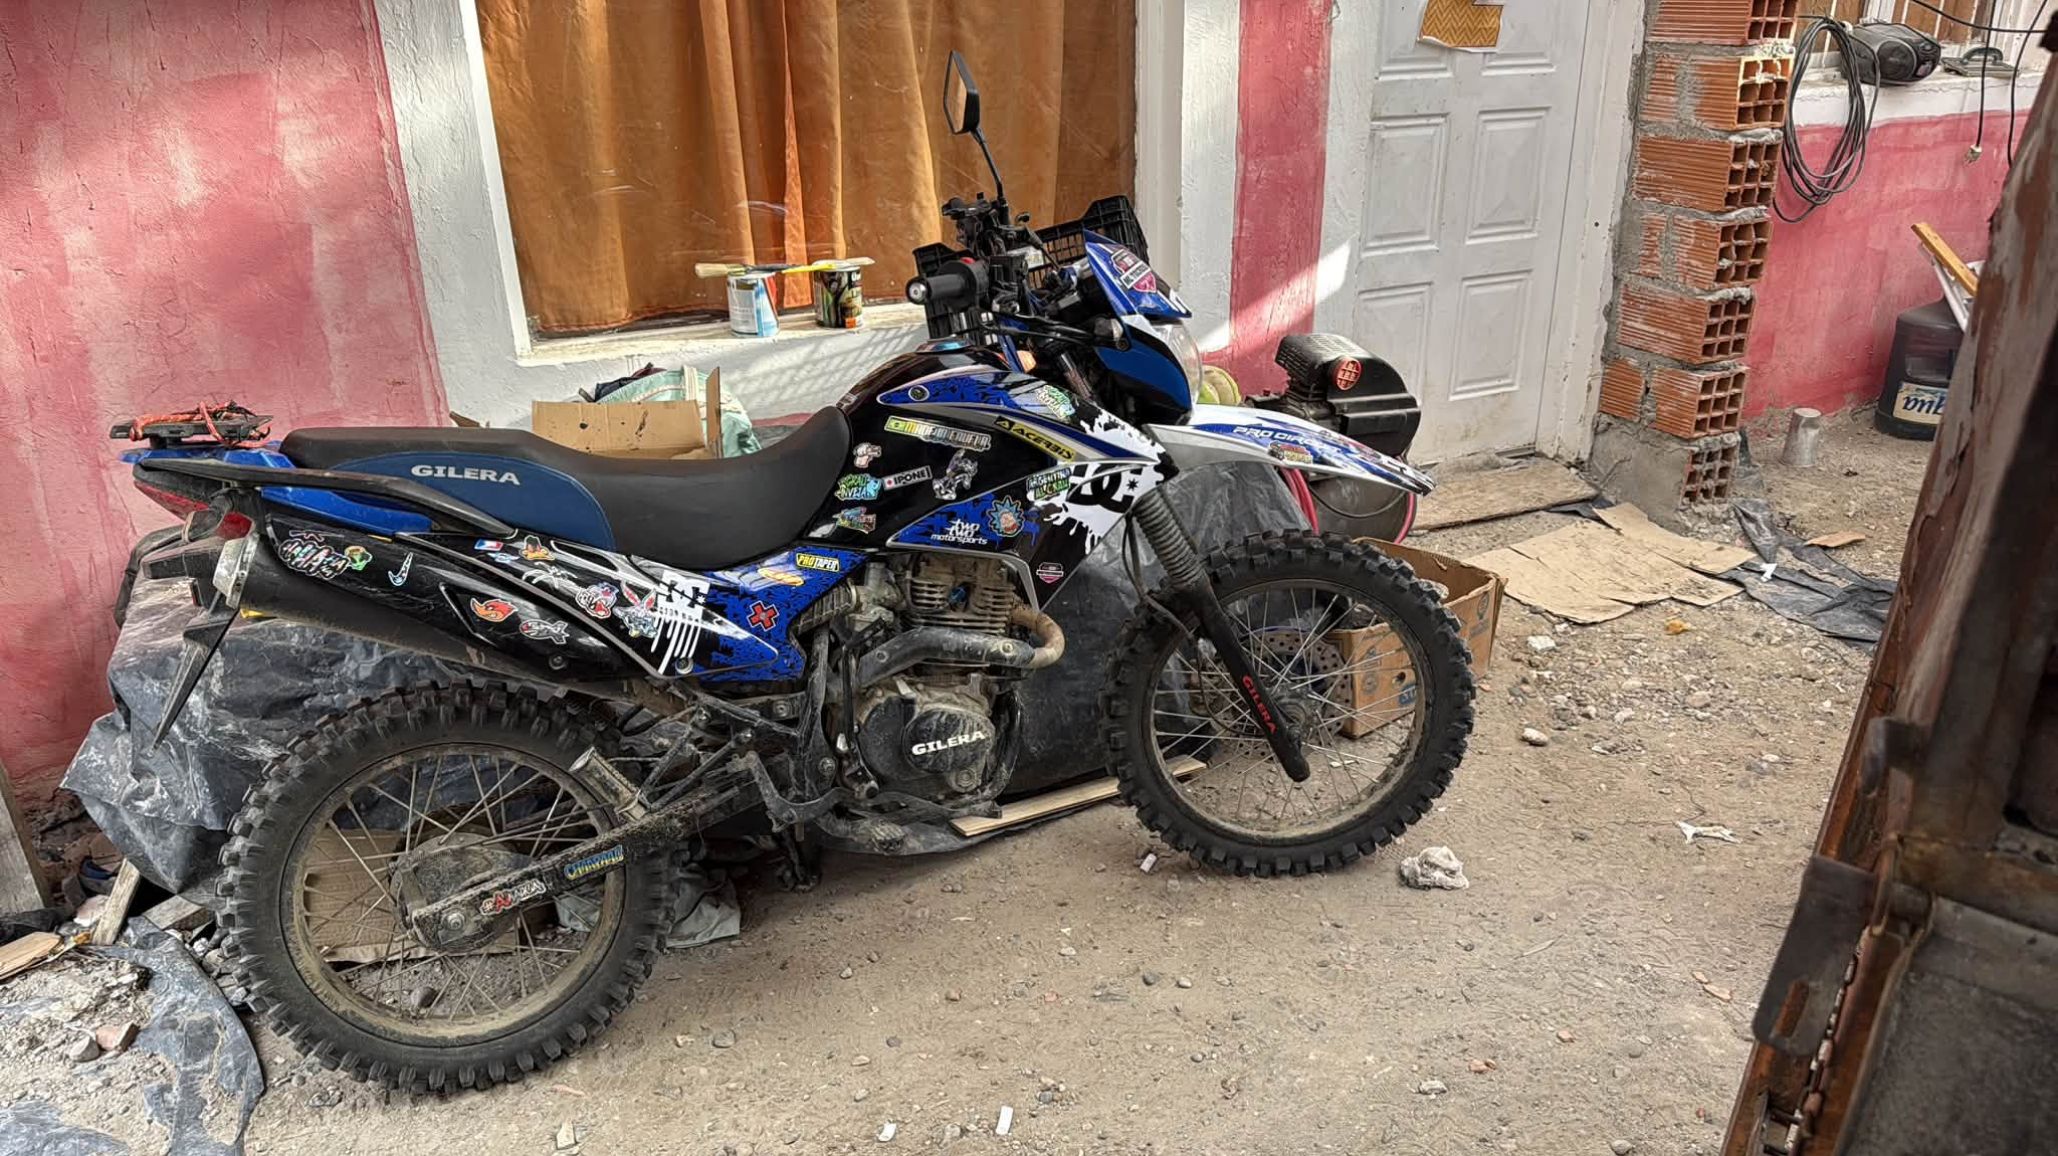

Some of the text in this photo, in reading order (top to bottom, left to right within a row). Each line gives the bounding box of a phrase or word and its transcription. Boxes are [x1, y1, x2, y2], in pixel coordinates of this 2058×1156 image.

[1012, 427, 1073, 459] ACERBIS
[1233, 426, 1272, 439] PRO
[411, 455, 520, 485] GILERA
[894, 470, 926, 485] IPONE
[930, 534, 988, 545] motorsports
[1242, 675, 1277, 734] GILERA
[911, 731, 985, 755] GILERA
